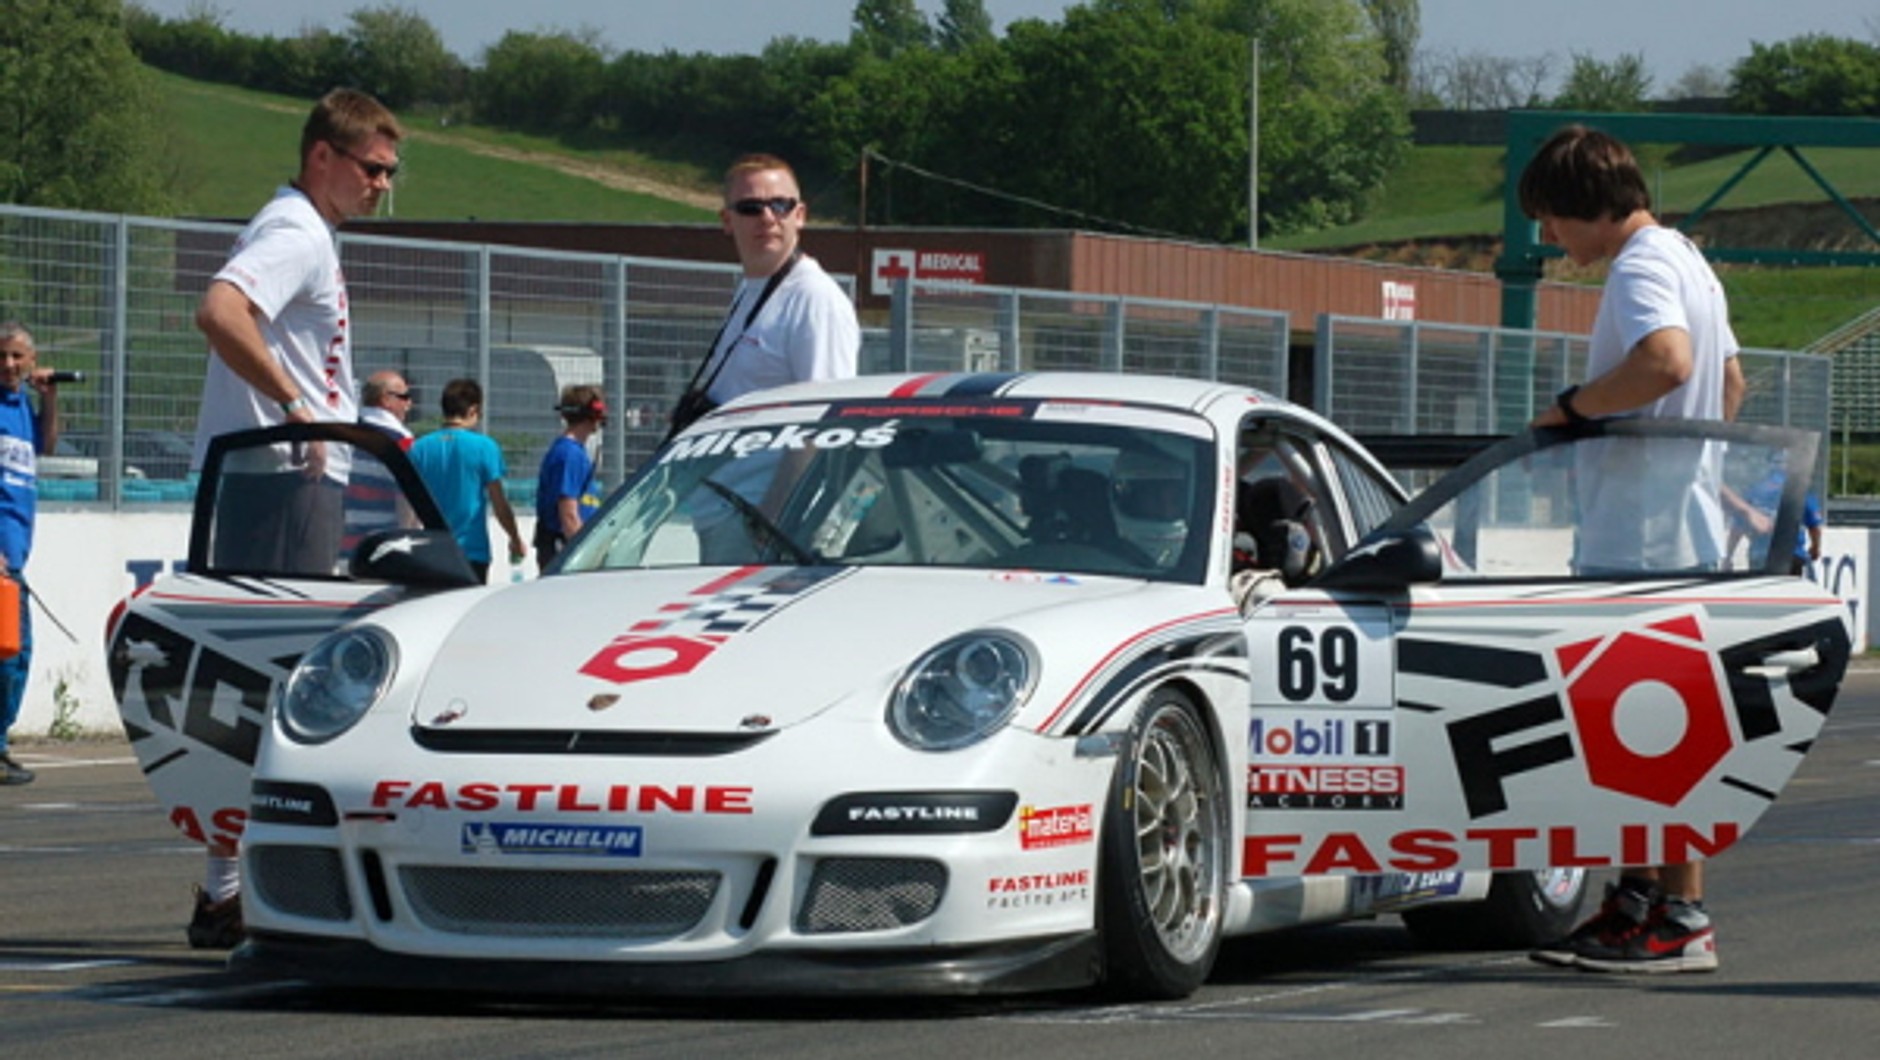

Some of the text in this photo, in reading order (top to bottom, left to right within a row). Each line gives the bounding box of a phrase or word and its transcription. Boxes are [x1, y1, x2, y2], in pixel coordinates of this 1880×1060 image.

[920, 253, 980, 270] MEDICAL
[1278, 625, 1358, 704] 69
[371, 781, 753, 814] FASTLINE
[848, 806, 979, 821] FASTLINE
[502, 828, 637, 849] MICHELIN
[988, 869, 1088, 893] FASTLINE
[987, 887, 1087, 909] racing art
